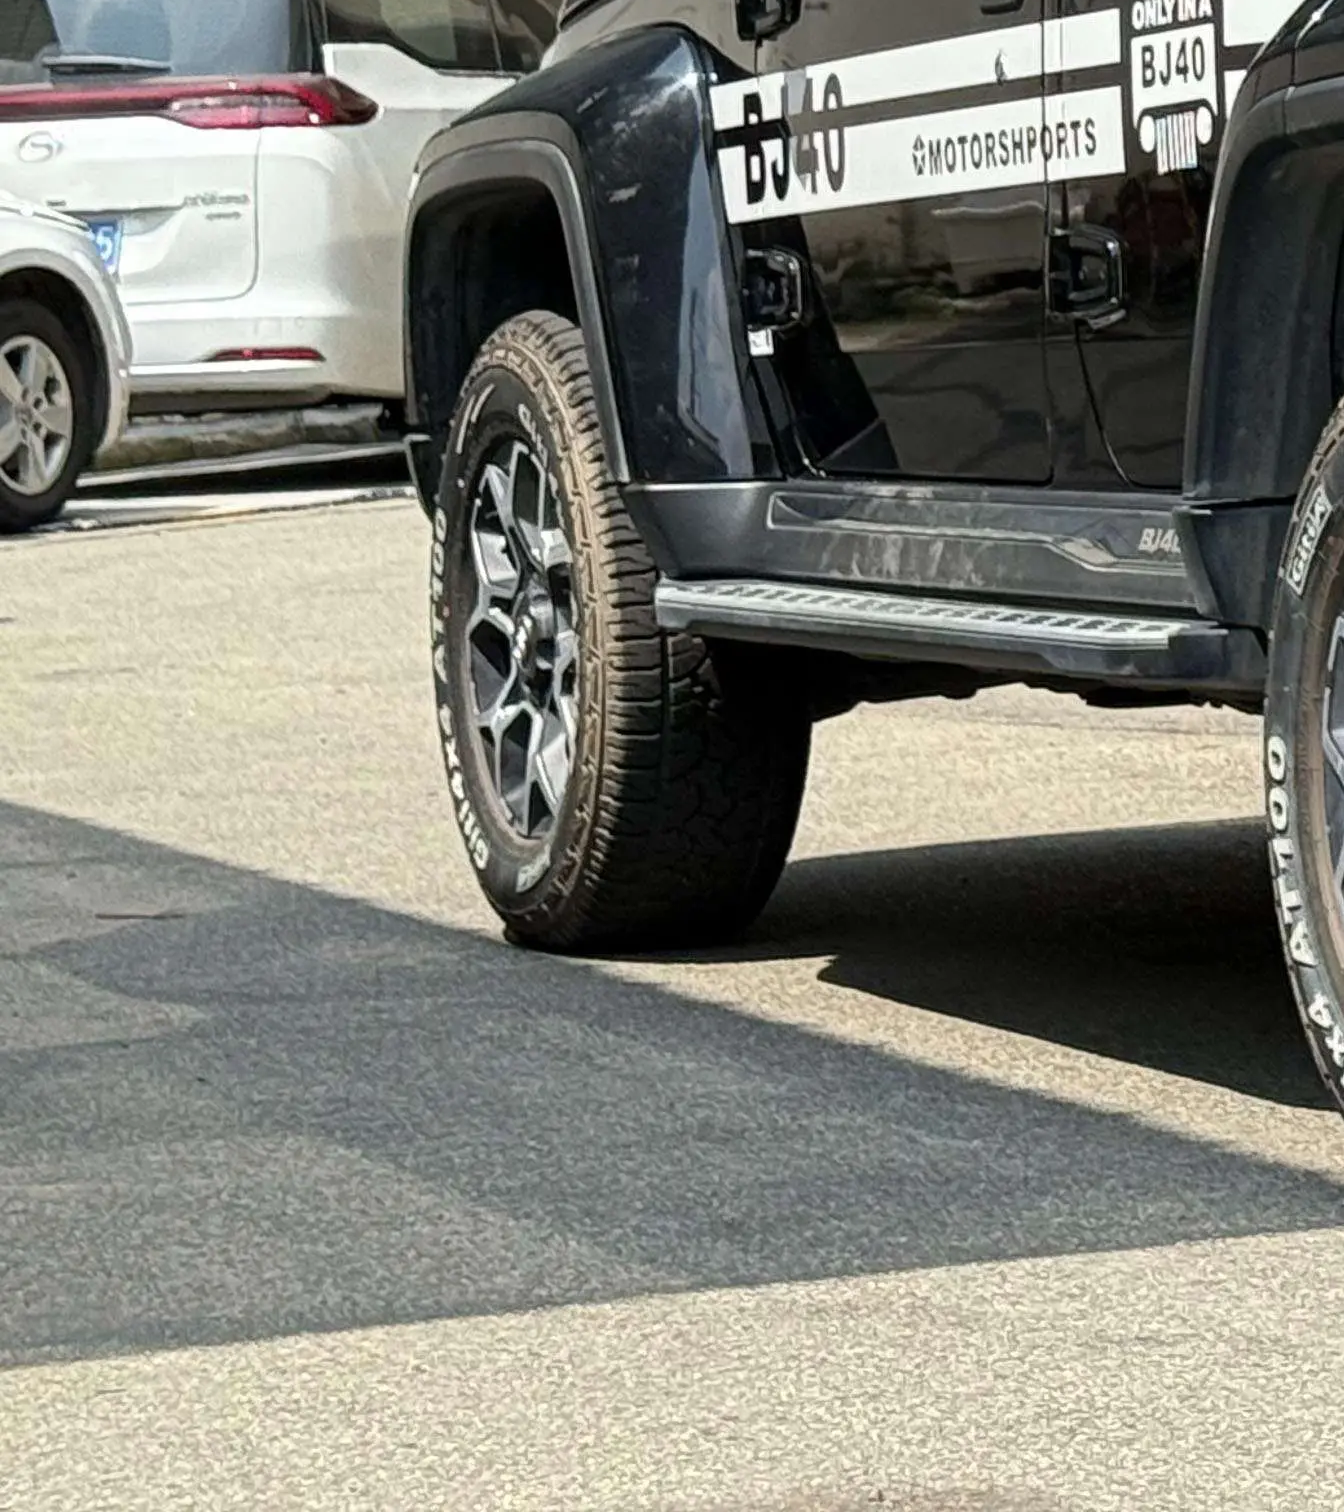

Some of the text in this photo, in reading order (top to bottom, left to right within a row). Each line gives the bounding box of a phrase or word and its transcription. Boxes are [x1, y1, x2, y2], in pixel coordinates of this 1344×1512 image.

[1141, 36, 1205, 88] BJ40
[743, 73, 845, 204] BJ40
[928, 117, 1096, 176] MOTORSHPORTS
